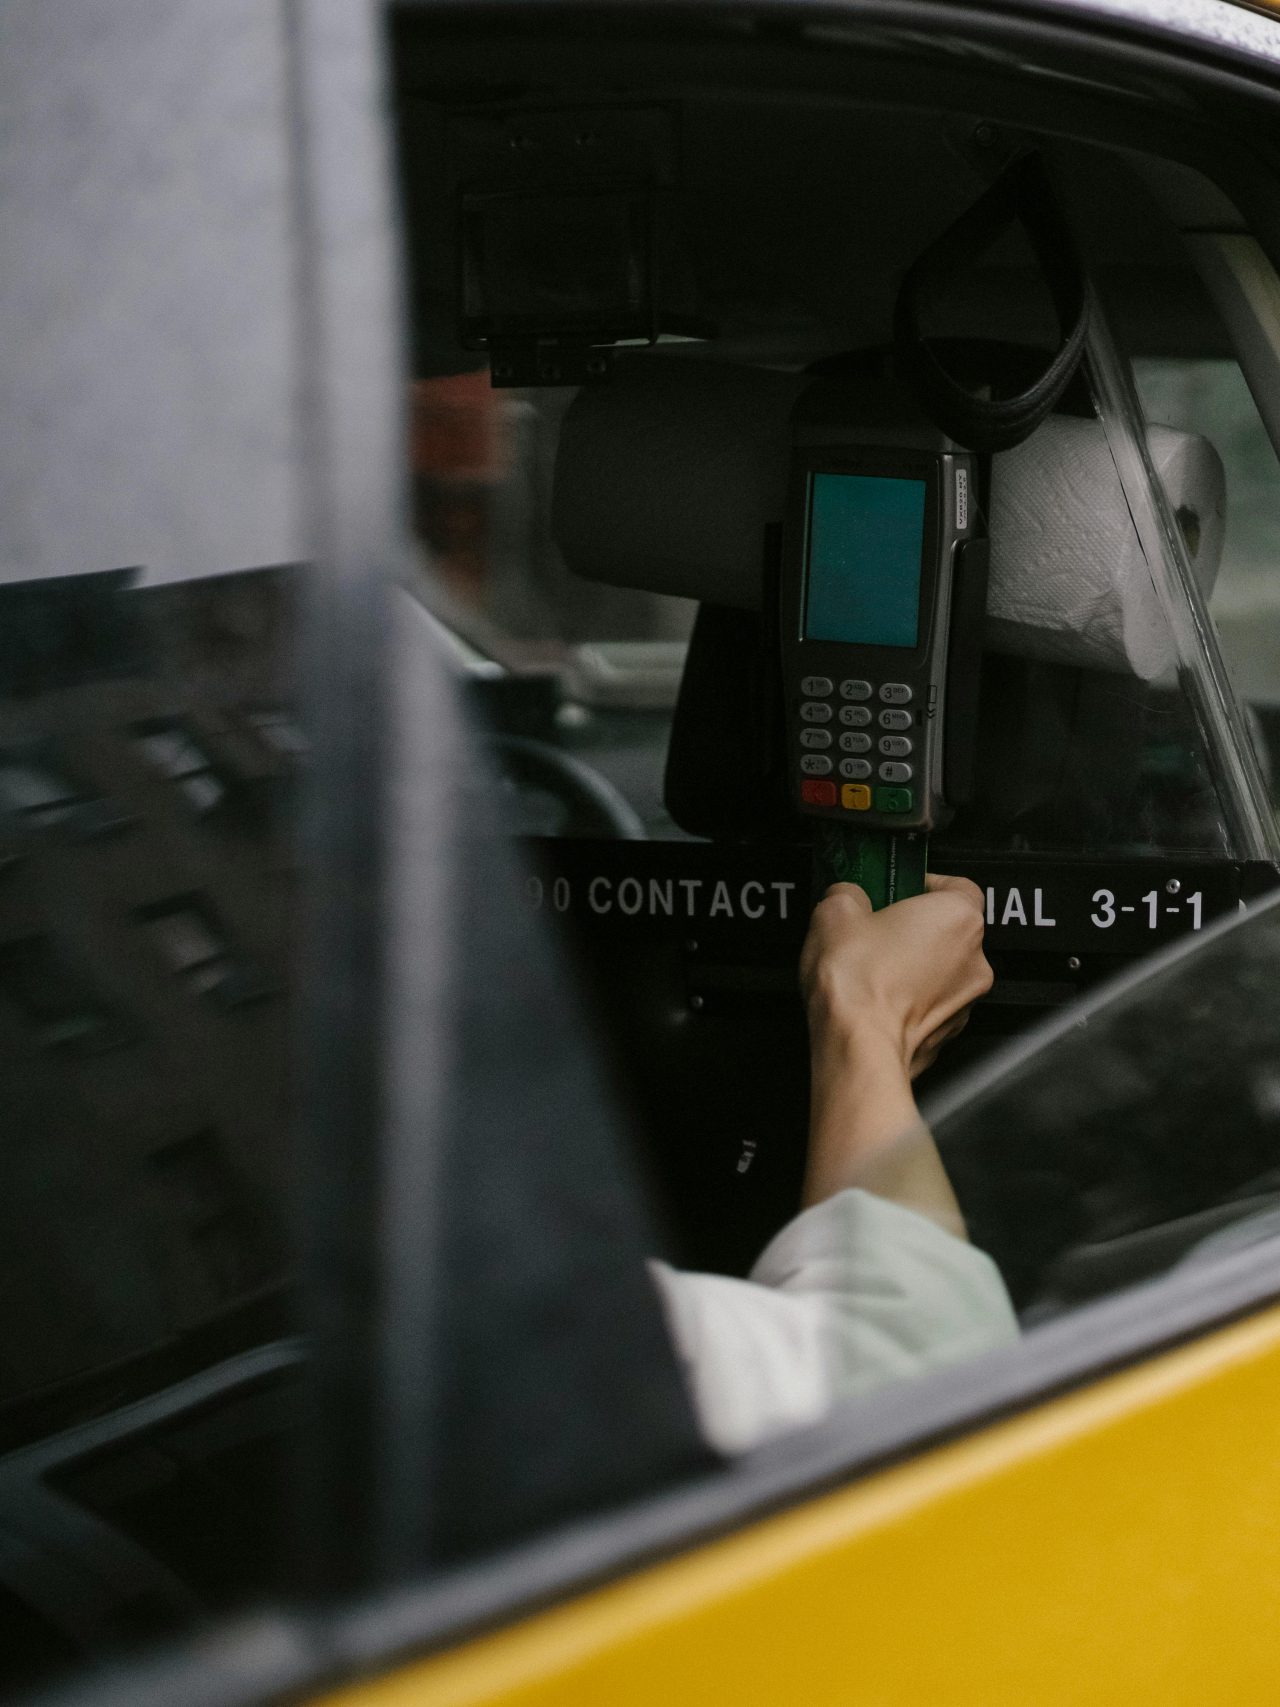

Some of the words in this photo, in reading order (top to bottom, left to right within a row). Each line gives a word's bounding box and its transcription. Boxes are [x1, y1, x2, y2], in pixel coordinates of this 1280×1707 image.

[807, 680, 814, 692] 1
[846, 683, 853, 697] 2
[884, 687, 892, 699] 3
[806, 706, 813, 718] 4
[845, 710, 853, 722] 5
[883, 712, 891, 725] 6
[805, 732, 813, 744] 7
[844, 736, 852, 748] 8
[883, 740, 891, 751] 9
[845, 762, 853, 774] 0
[588, 876, 796, 919] CONTACT
[985, 887, 1056, 928] IAL
[1090, 888, 1203, 931] 3-1-1
